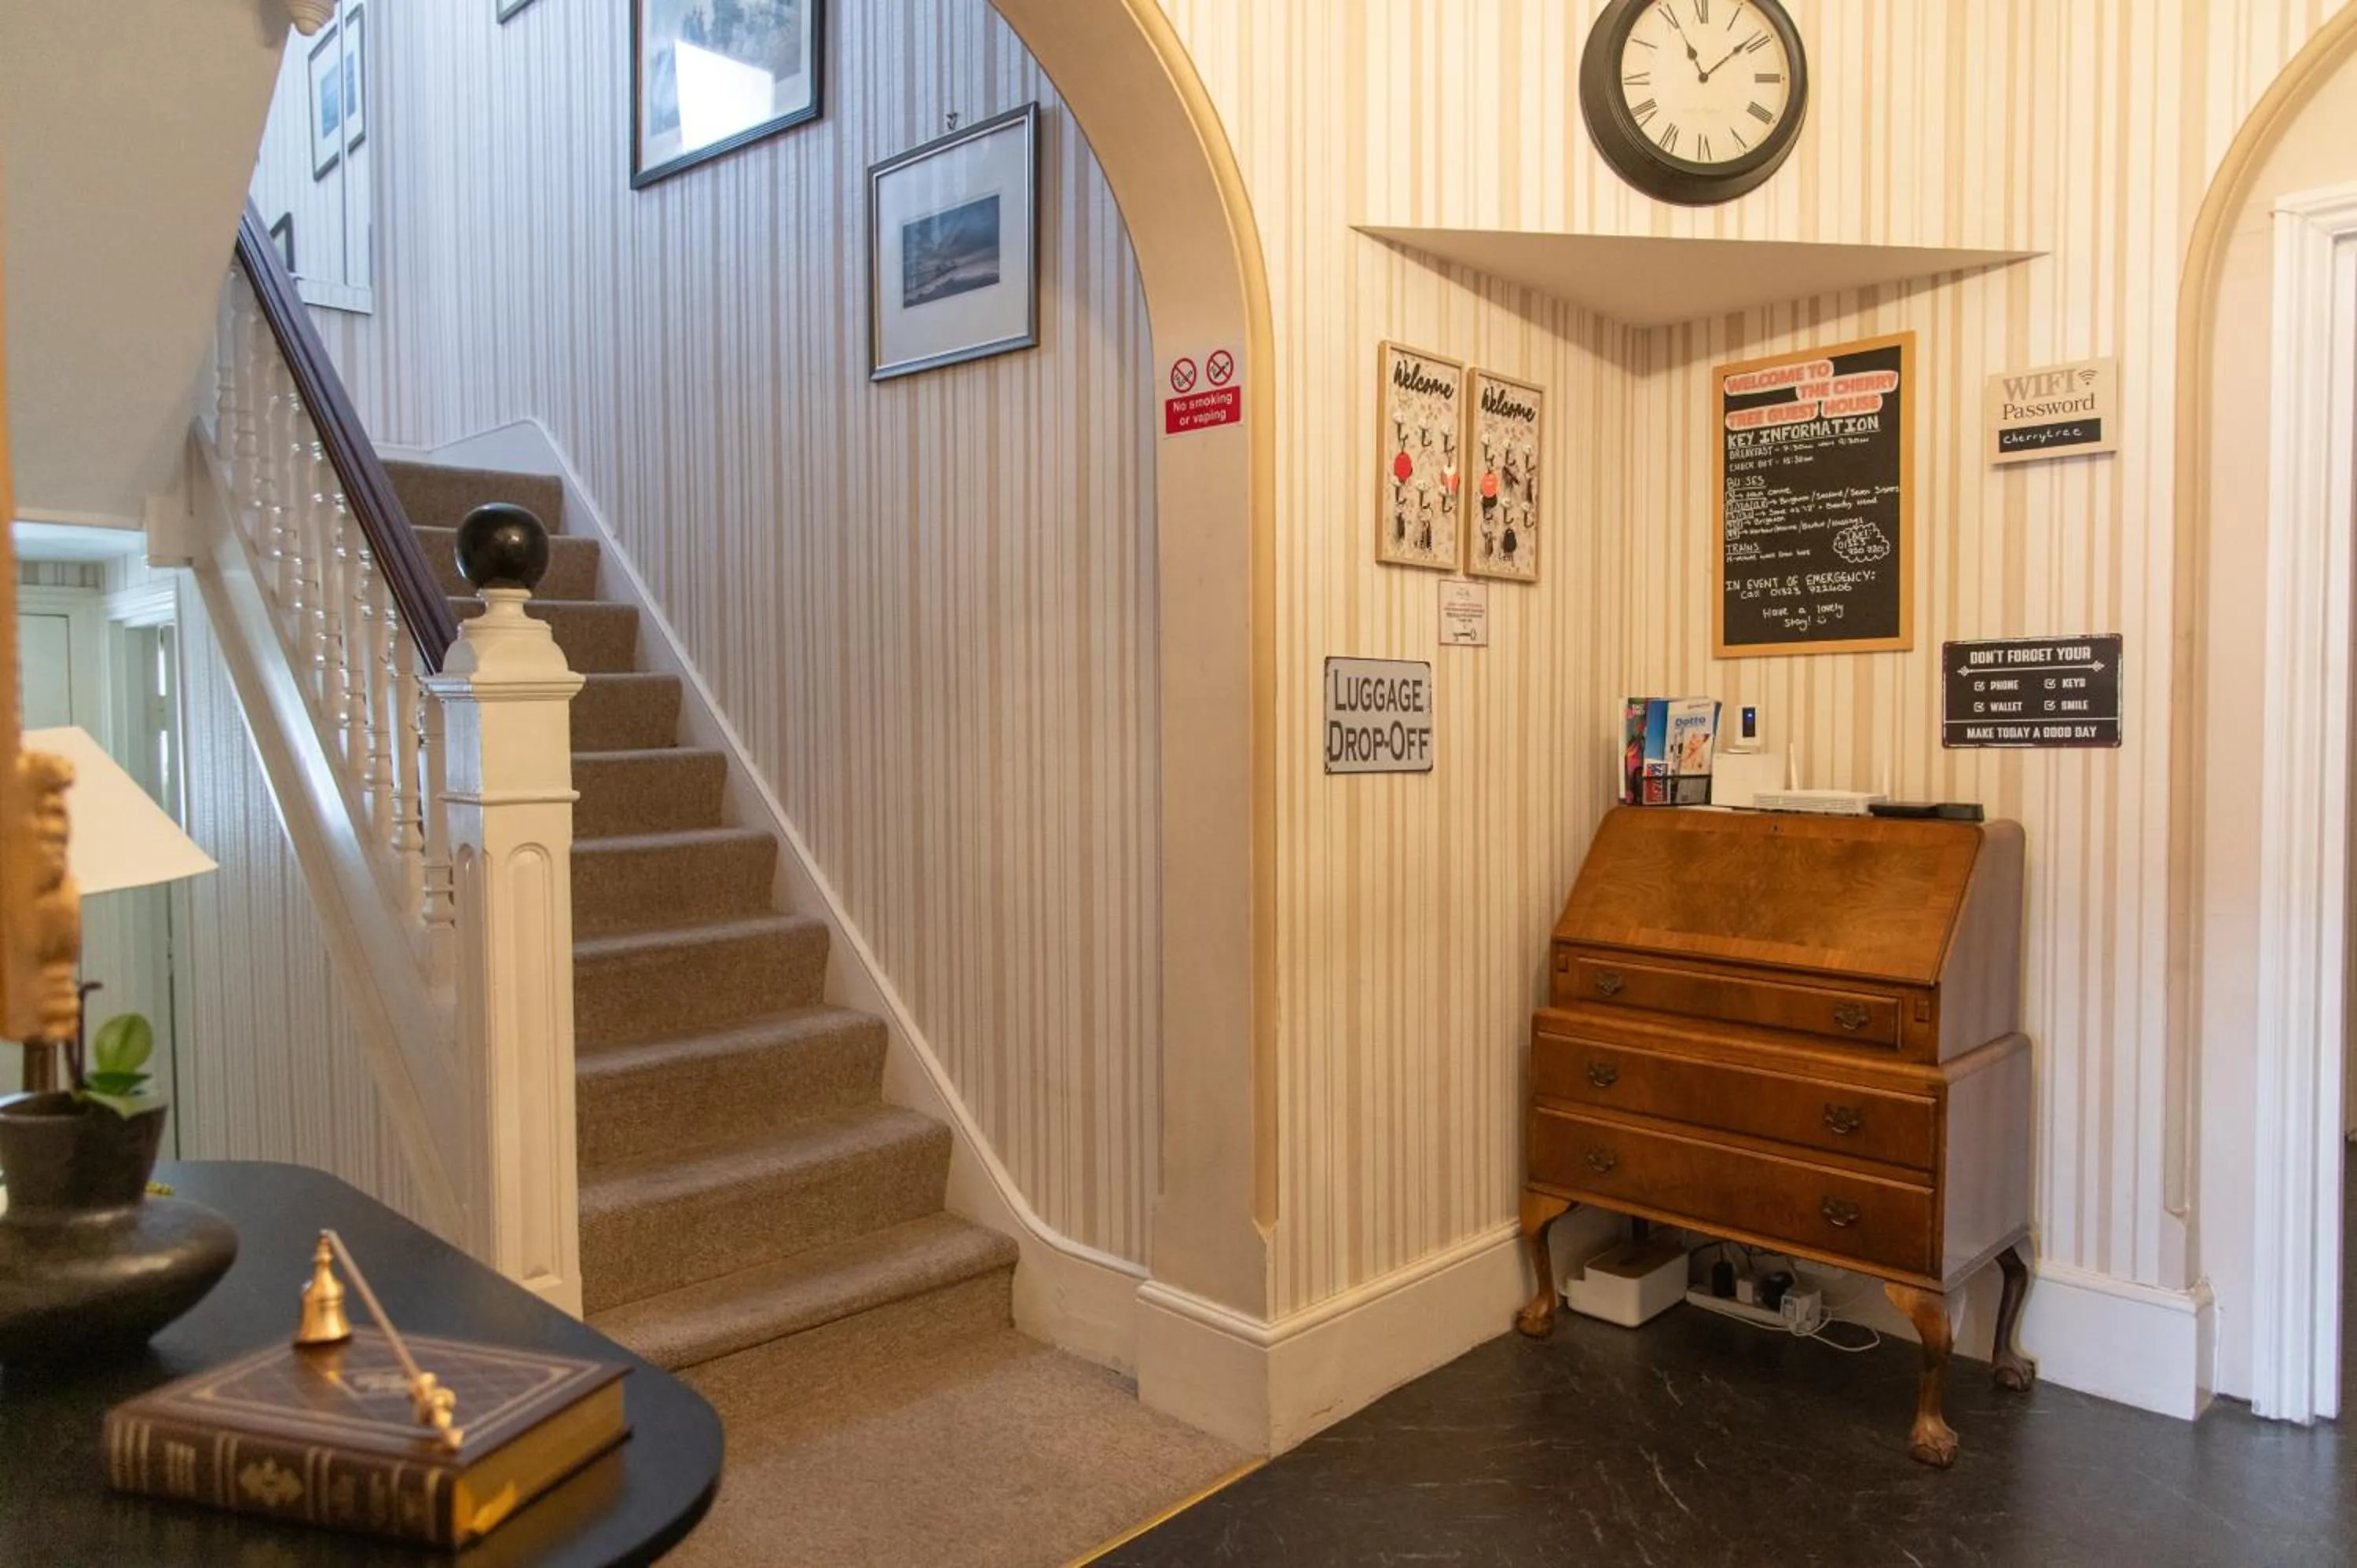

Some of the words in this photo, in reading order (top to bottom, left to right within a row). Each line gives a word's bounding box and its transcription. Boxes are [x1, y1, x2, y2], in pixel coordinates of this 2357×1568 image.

[1394, 359, 1453, 399] Welcome
[1728, 367, 1805, 391] WELCOME
[1808, 363, 1830, 378] TO
[1800, 383, 1830, 399] THE
[1834, 372, 1896, 393] CHERRY
[2002, 368, 2077, 401] WIFI
[1173, 401, 1186, 412] No
[1189, 393, 1232, 409] smoking
[1481, 387, 1535, 423] Welcome
[1730, 409, 1763, 427] TREE
[1767, 403, 1816, 423] GUEST
[1824, 396, 1879, 416] HOUSE
[2003, 392, 2095, 420] Password
[1179, 416, 1189, 426] or
[1193, 409, 1226, 423] vaping
[1728, 430, 1754, 450] KEY
[1759, 415, 1879, 444] INFORMATION
[2003, 428, 2082, 443] cherrytree
[1729, 445, 1772, 460] BREAKFAST
[1729, 461, 1754, 471] CHECK
[1725, 580, 1739, 591] IN
[1747, 577, 1778, 590] EVENT
[1787, 575, 1798, 587] OF
[1805, 570, 1876, 586] EMERGENCY:
[1762, 606, 1789, 619] Have
[1817, 603, 1844, 619] lovely
[1970, 650, 2004, 665] DON'T
[2007, 648, 2053, 663] FORGET
[2057, 647, 2091, 661] YOUR
[1334, 669, 1424, 712] LUGGAGE
[1990, 680, 2018, 691] PHONE
[2062, 678, 2086, 688] KEYS
[1990, 702, 2022, 712] WALLET
[2061, 700, 2089, 710] SMILE
[1675, 716, 1706, 727] Dotto
[1329, 720, 1431, 762] DROP-OFF
[1967, 727, 1995, 739] MAKE
[1997, 727, 2031, 739] TODAY
[2033, 727, 2040, 738] A
[2044, 726, 2072, 738] GOOD
[2075, 725, 2097, 737] DAY
